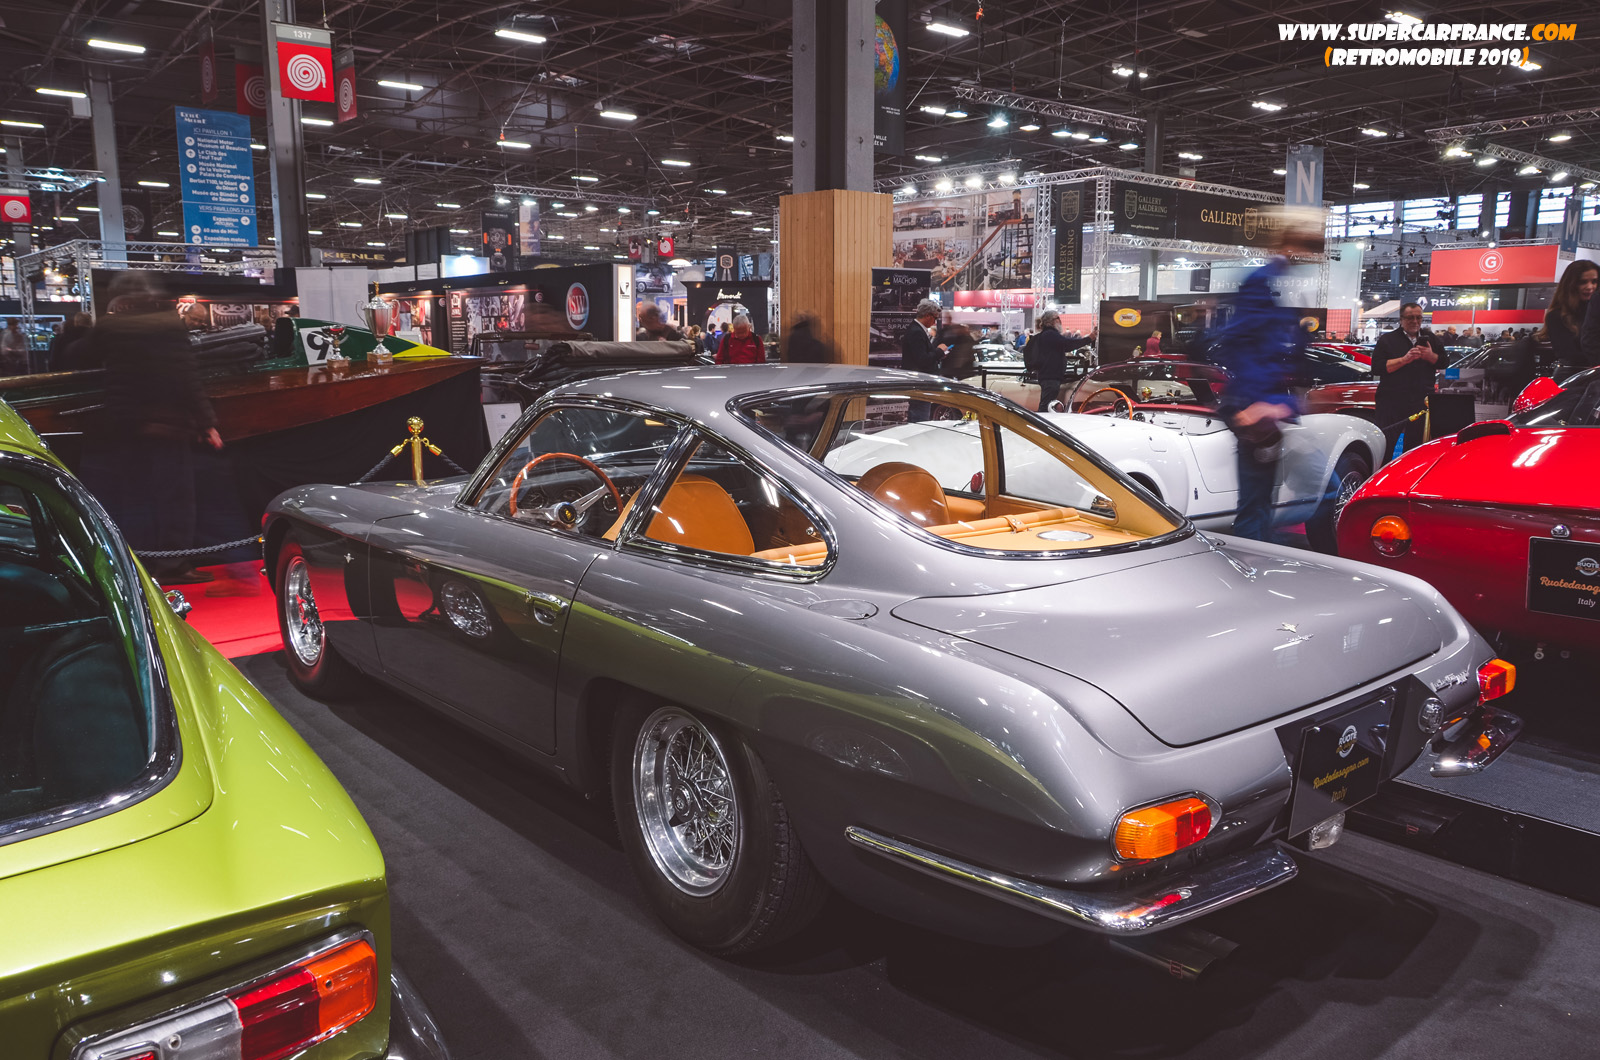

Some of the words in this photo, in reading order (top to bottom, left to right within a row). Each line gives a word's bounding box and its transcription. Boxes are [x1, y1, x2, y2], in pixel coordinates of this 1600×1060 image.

[293, 30, 312, 39] 1317
[1295, 161, 1316, 203] N
[1138, 196, 1161, 205] GALLERY
[1138, 204, 1168, 213] AALDERING
[1201, 208, 1244, 226] GALLERY
[1565, 210, 1579, 241] M
[324, 252, 385, 260] KIENLE
[1485, 256, 1496, 268] G
[1059, 243, 1067, 290] GALLERY
[1540, 576, 1600, 595] Ruotedasog
[1578, 598, 1596, 607] Italy
[1339, 732, 1357, 745] RUOTE
[1313, 757, 1369, 789] Ruotedasogno.com
[1331, 786, 1347, 803] Italy
